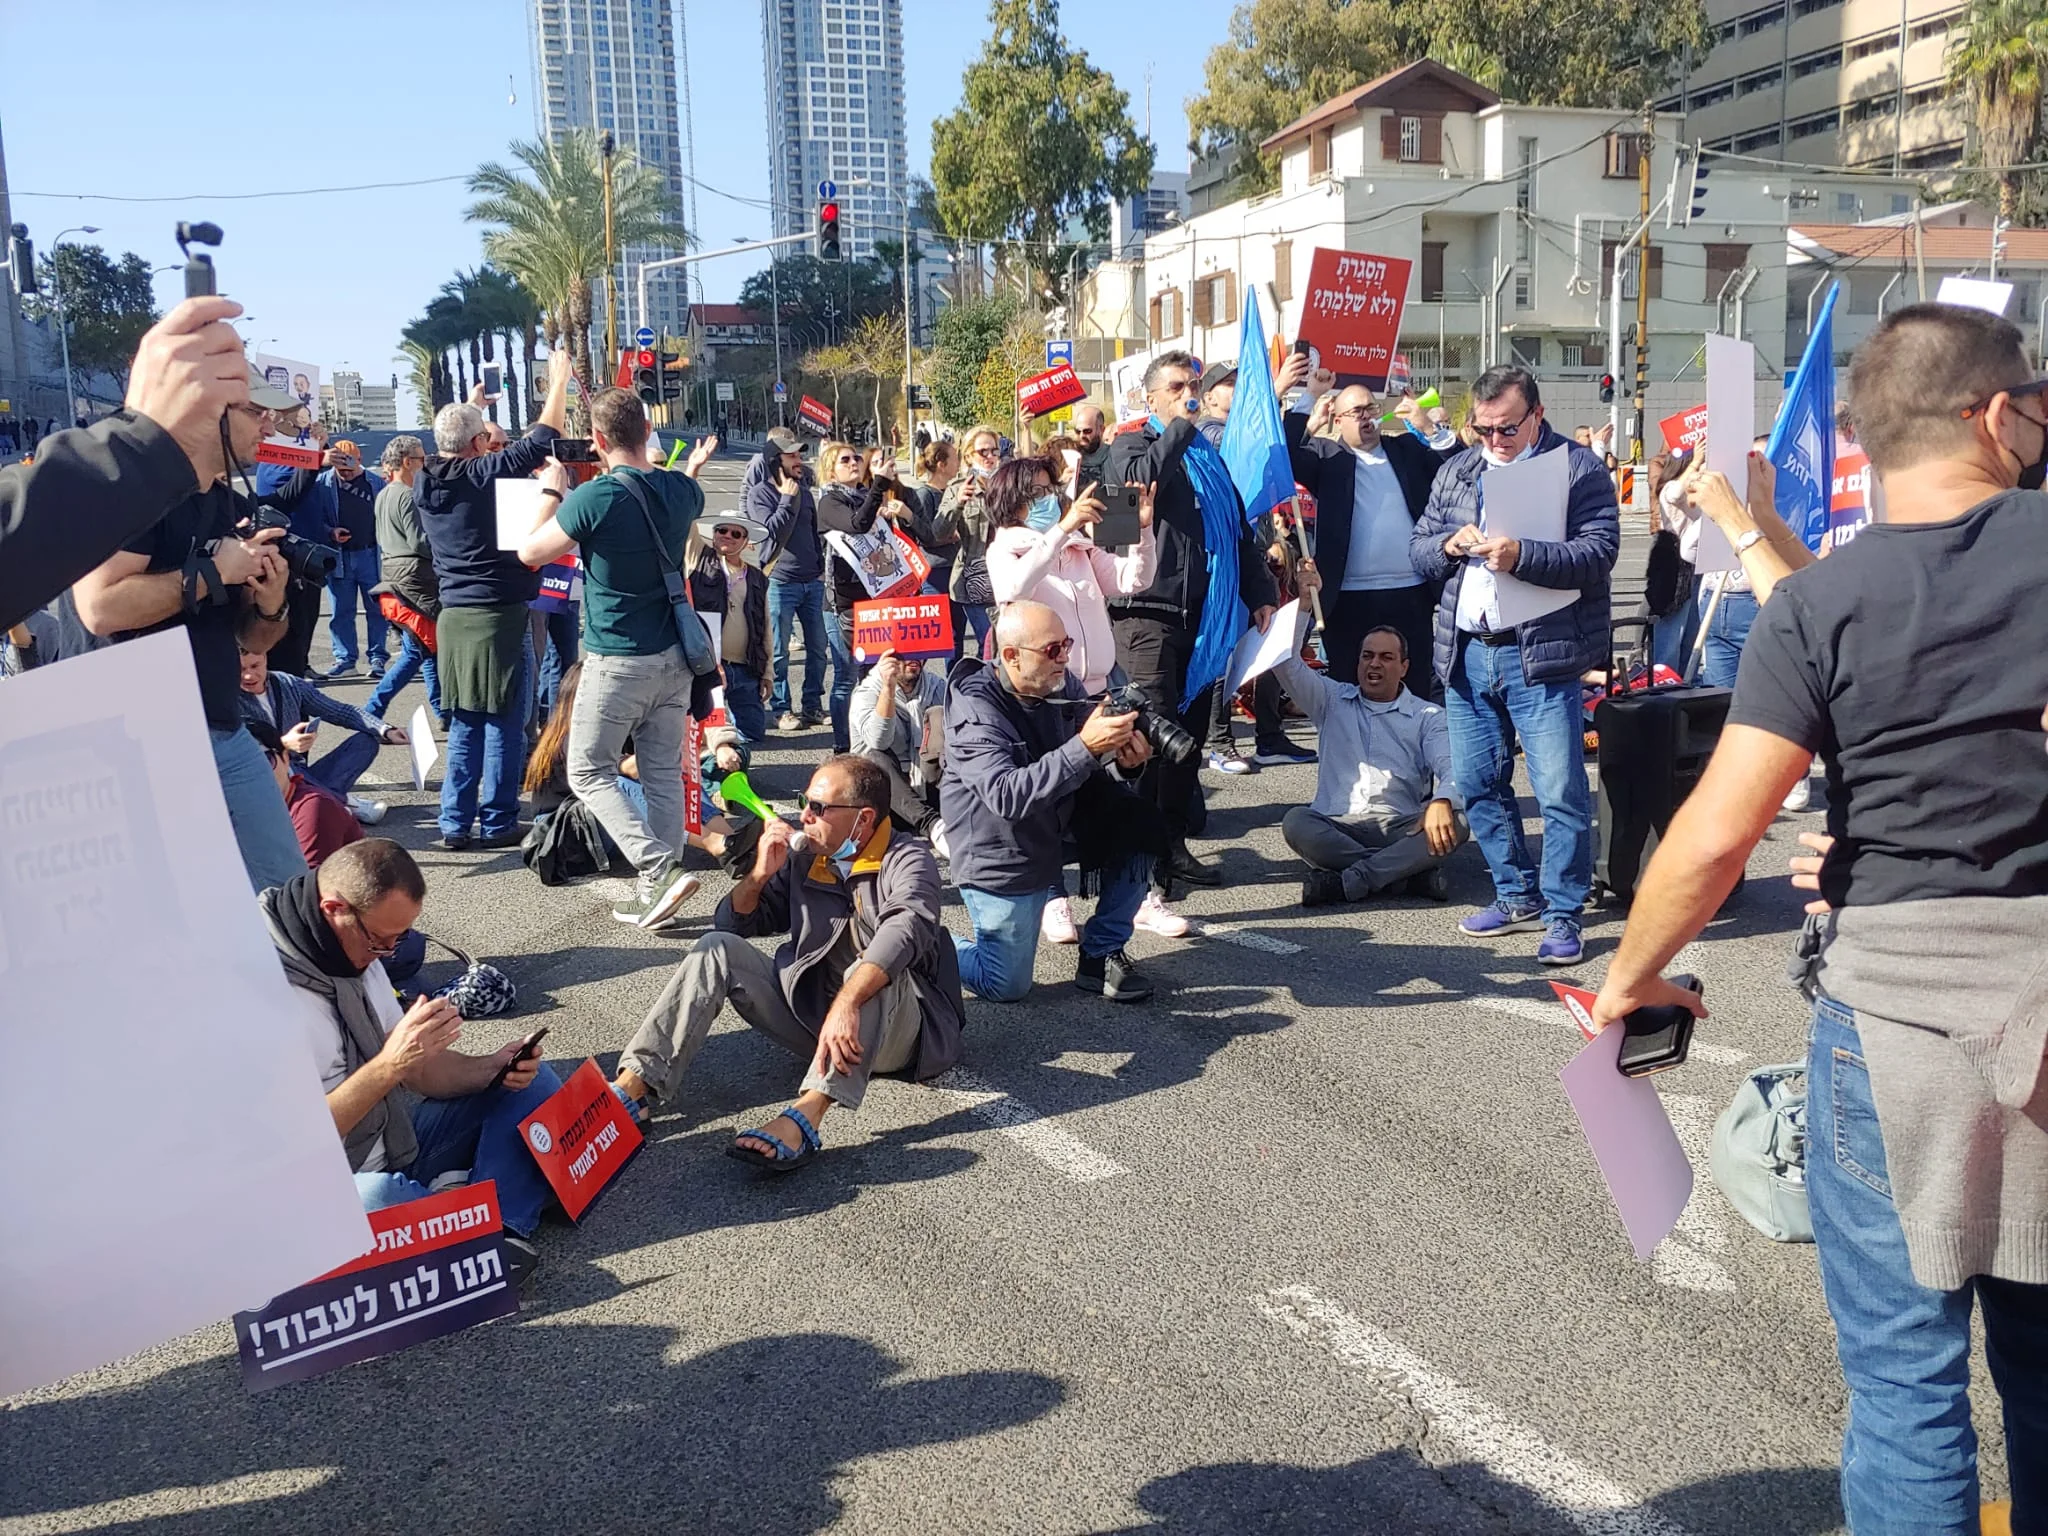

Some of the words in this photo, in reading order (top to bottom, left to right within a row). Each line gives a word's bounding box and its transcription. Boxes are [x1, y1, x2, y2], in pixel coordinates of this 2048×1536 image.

[1334, 341, 1367, 357] אולטרה
[1368, 344, 1388, 362] מלון
[1039, 378, 1051, 391] זה
[1050, 369, 1073, 386] היום
[919, 604, 940, 618] את
[858, 626, 892, 644] אחרת
[897, 619, 941, 641] לנהל
[586, 1091, 612, 1129] תיירות
[559, 1118, 586, 1156] נכנסת
[595, 1120, 620, 1152] אוצר
[568, 1141, 599, 1185] לאומי!
[419, 1202, 490, 1241] תפתחו
[376, 1225, 414, 1253] את
[450, 1247, 503, 1291] תנו
[389, 1264, 440, 1312] לנו
[249, 1284, 378, 1358] לעבוד!
